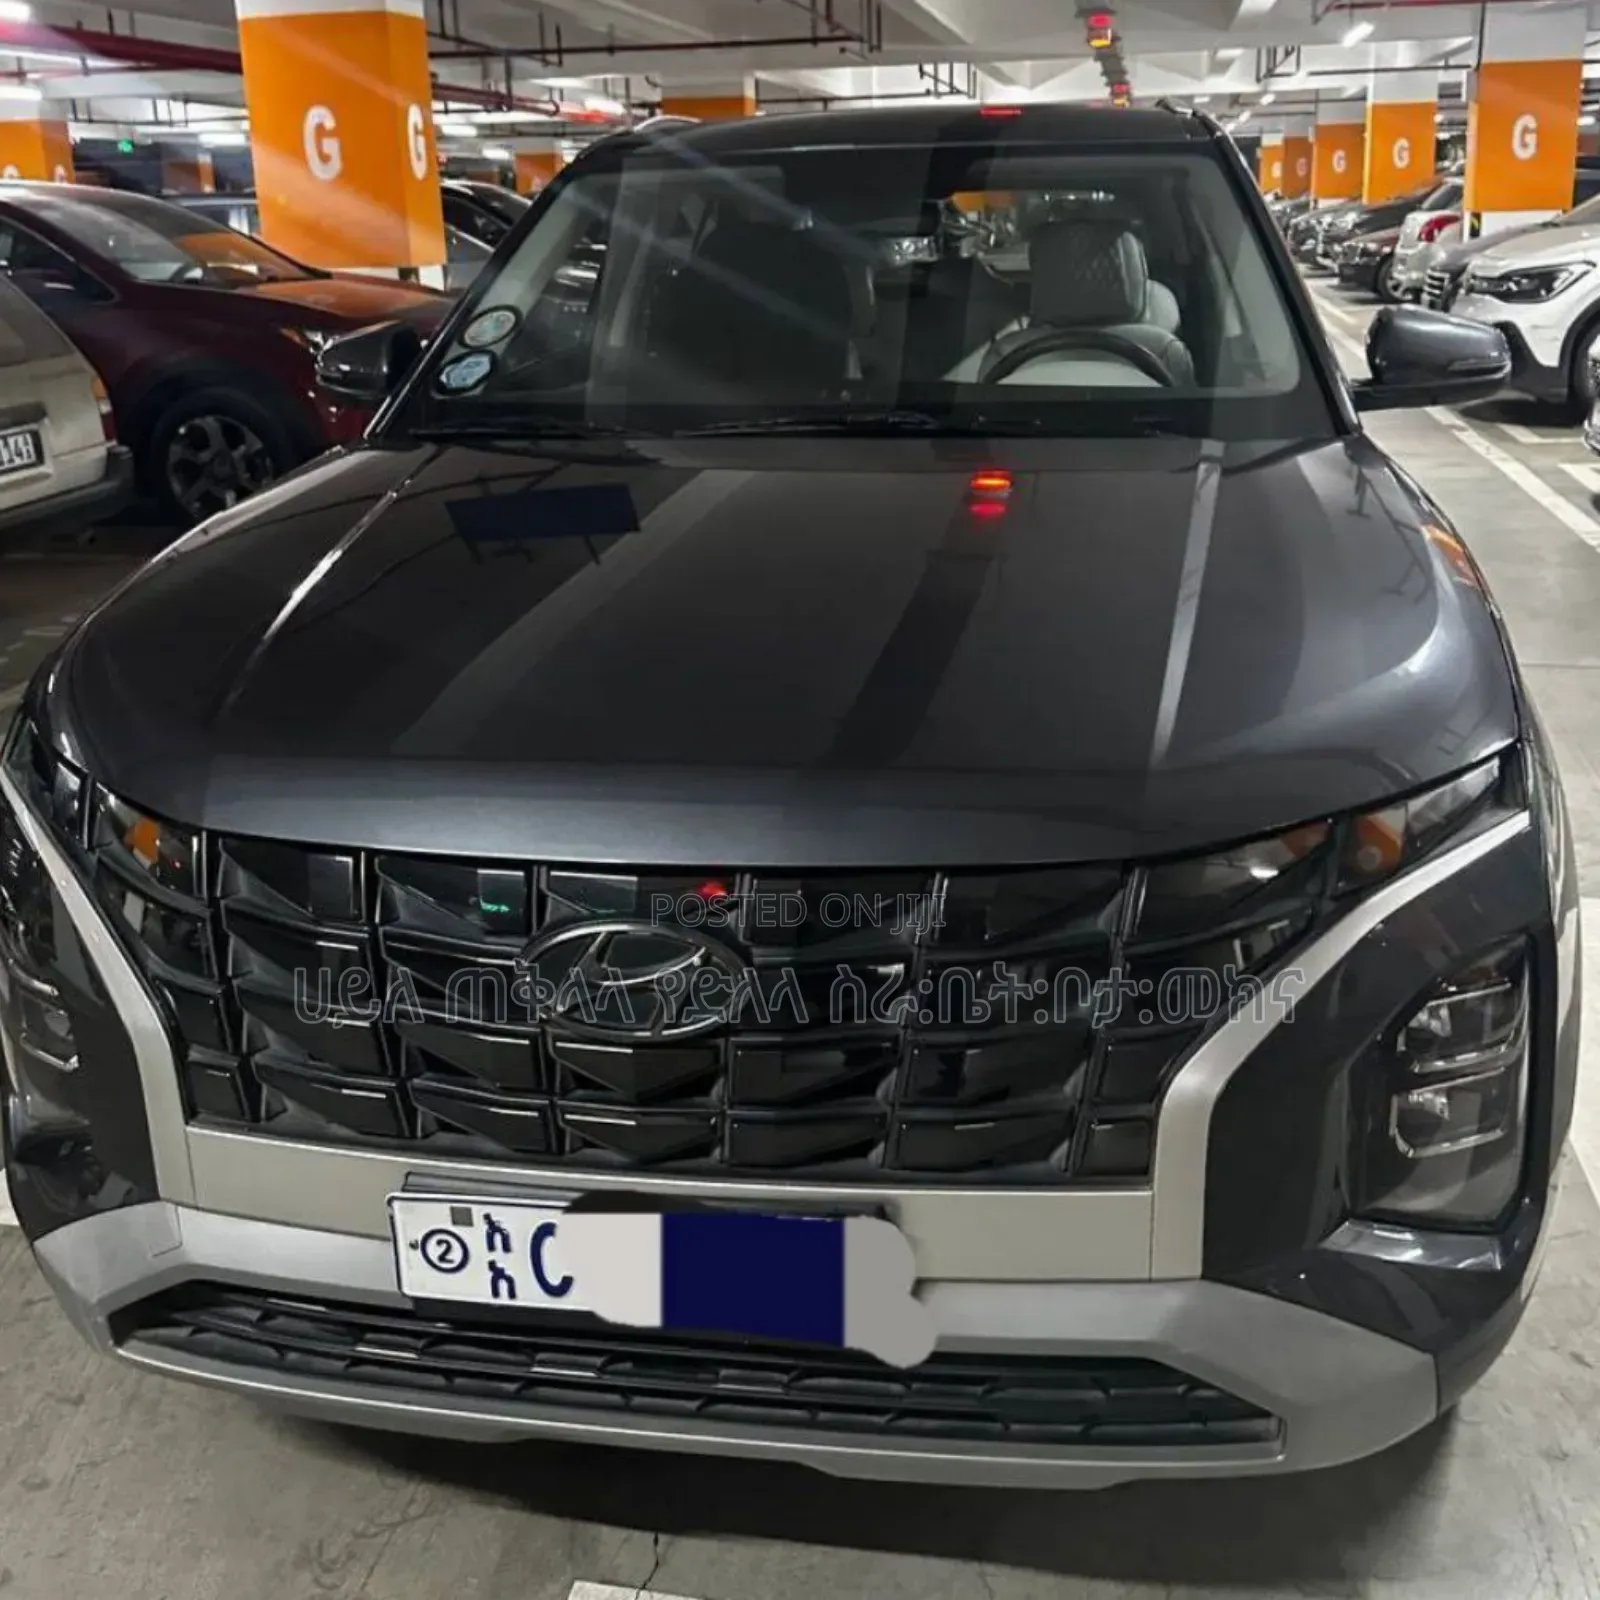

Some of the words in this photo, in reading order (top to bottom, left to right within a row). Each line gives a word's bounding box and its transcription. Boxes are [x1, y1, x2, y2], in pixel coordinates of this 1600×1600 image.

[303, 103, 342, 182] G
[407, 103, 427, 180] G
[1392, 137, 1411, 169] G
[1512, 113, 1538, 160] G
[1332, 149, 1346, 173] G
[435, 1238, 455, 1264] 2
